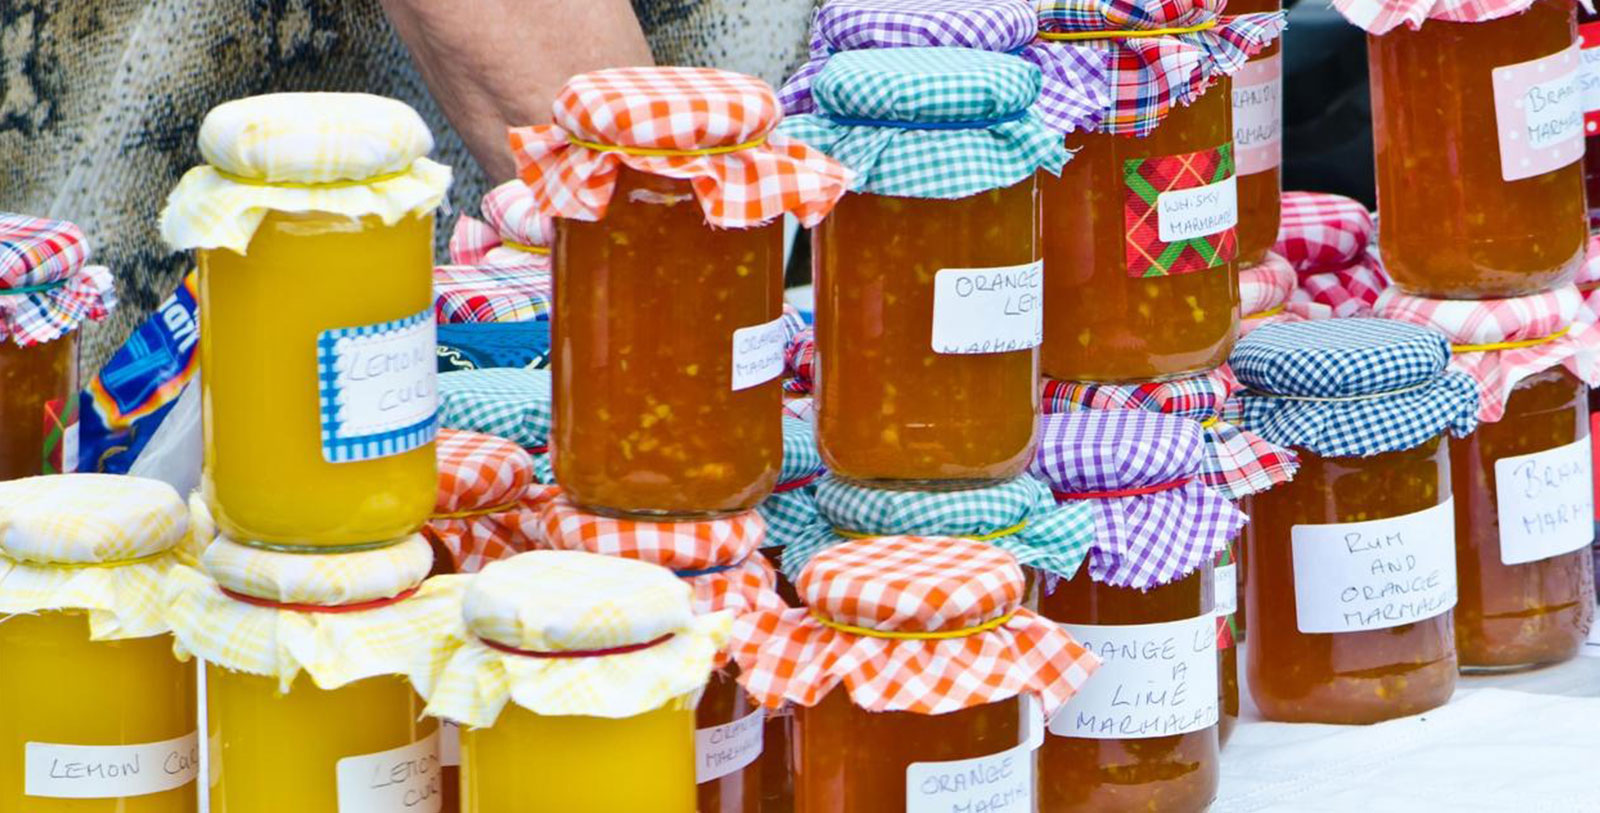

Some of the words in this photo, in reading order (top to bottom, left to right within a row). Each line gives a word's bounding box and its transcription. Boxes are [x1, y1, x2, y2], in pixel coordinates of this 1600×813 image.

[1371, 554, 1416, 576] AND
[1341, 570, 1440, 603] ORANGE
[50, 753, 140, 779] LEMON
[921, 756, 1014, 795] ORANGE
